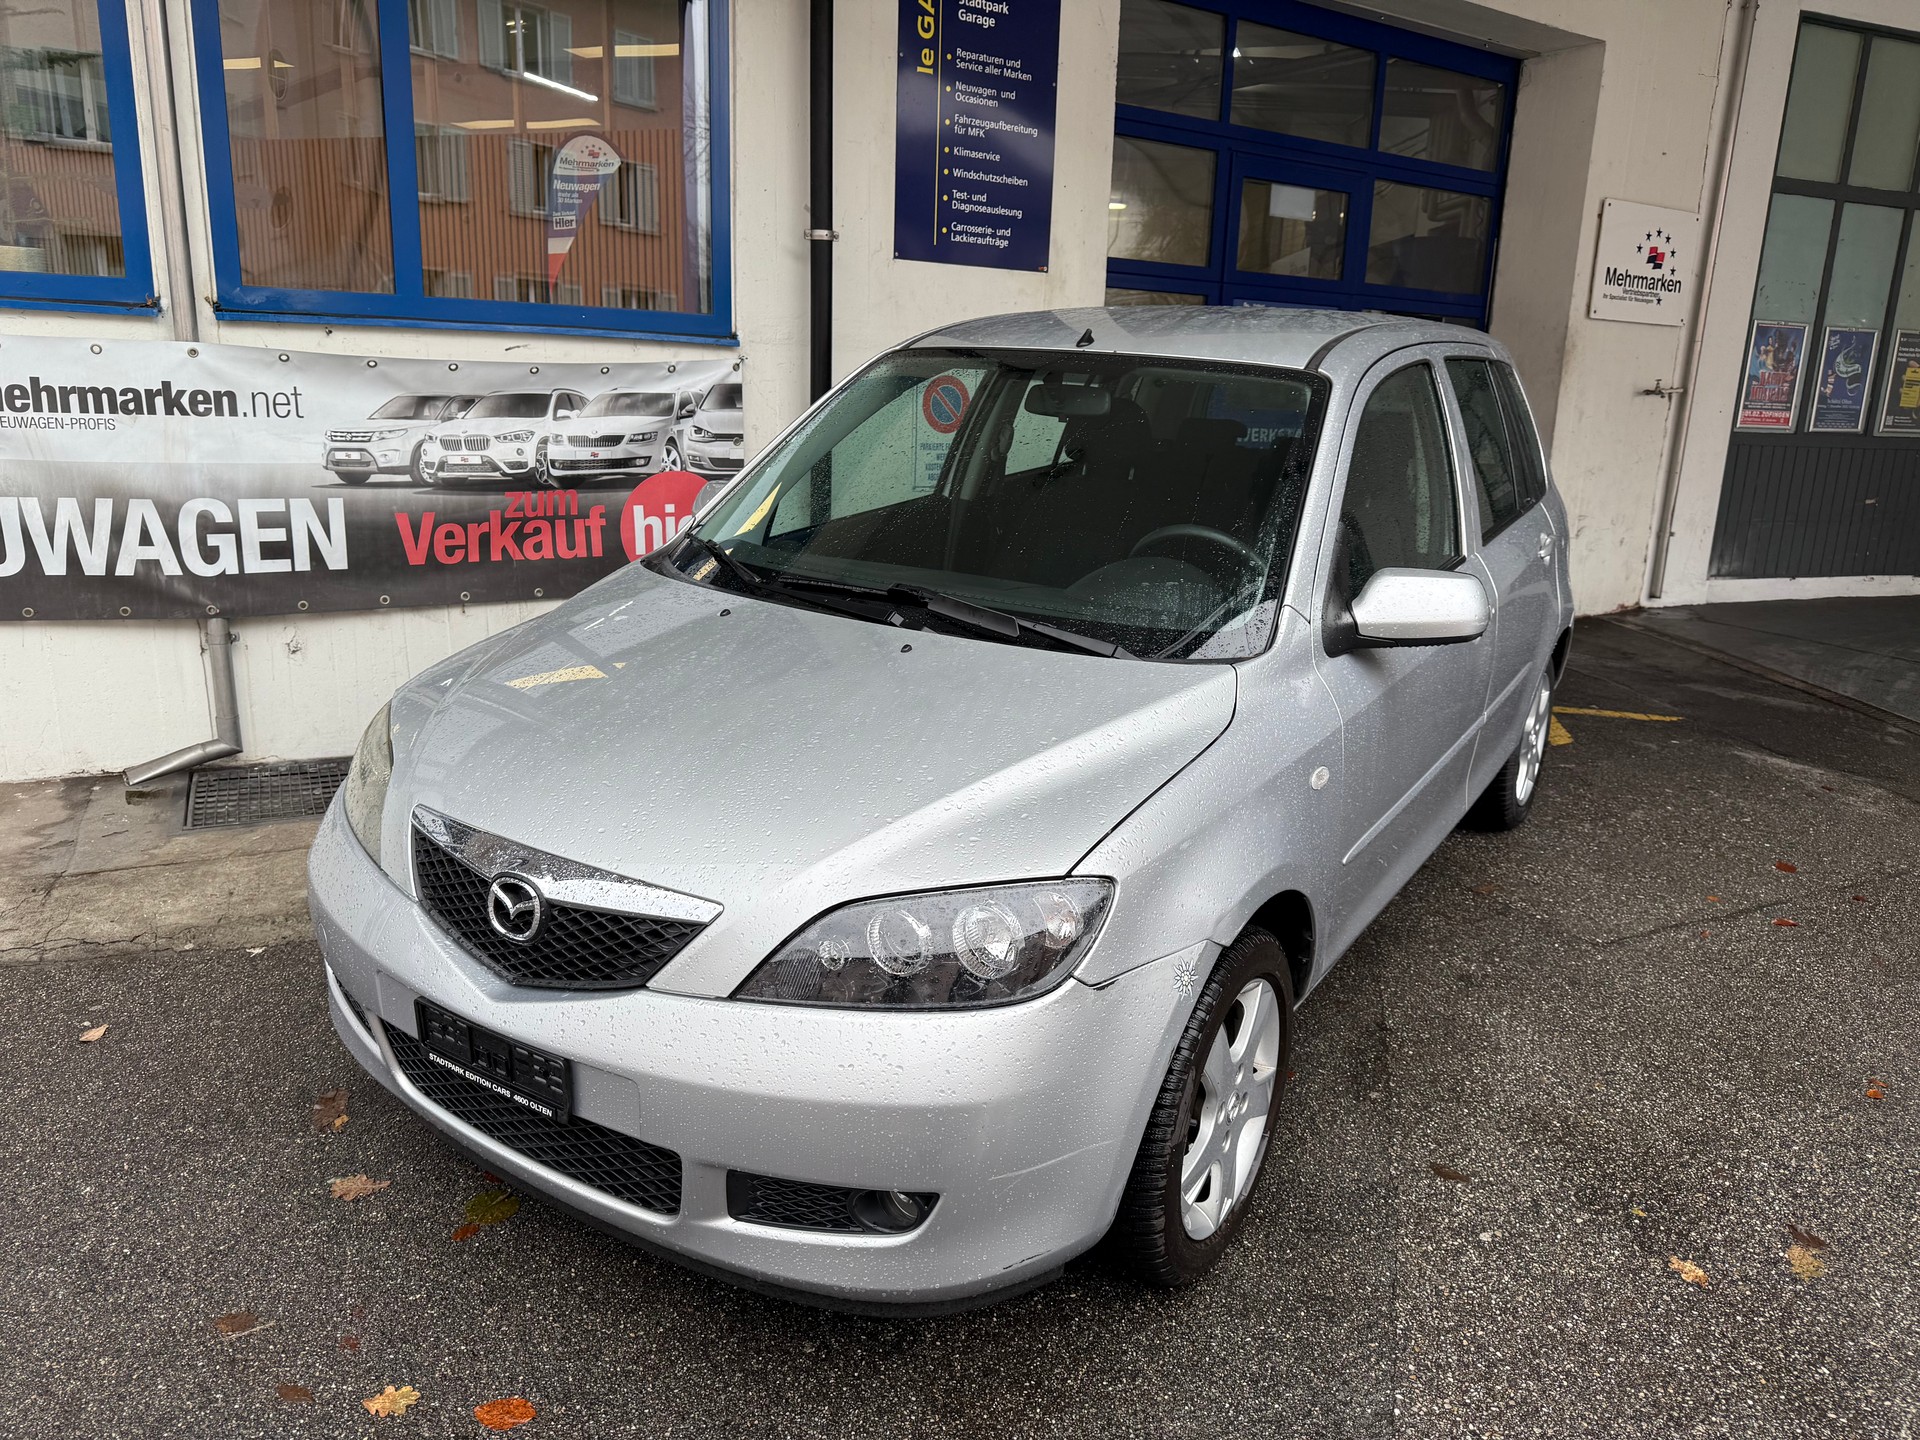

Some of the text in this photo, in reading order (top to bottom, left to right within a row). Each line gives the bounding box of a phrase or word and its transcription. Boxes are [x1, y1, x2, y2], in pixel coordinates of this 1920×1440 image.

[958, 9, 996, 29] Garage
[917, 48, 934, 75] le
[956, 48, 1021, 69] Reparaturen und
[956, 59, 1032, 82] Service aller Marken
[955, 81, 1016, 100] Neuwagen und
[955, 92, 999, 108] Occasionen
[954, 114, 1038, 138] Fahrzeugaufbereitung
[954, 124, 986, 138] für MFK
[559, 157, 615, 168] Mehrmarken
[953, 146, 1001, 162] Klimaservice
[553, 179, 601, 193] Neuwagen
[952, 168, 1029, 187] Windschutzscheiben
[952, 189, 987, 202] Test- und
[952, 201, 1023, 219] Diagnoseauslesung
[951, 221, 1012, 237] Carrosserie- und
[951, 233, 1009, 249] Lackieraufträge
[1604, 266, 1682, 294] Mehrmarken
[504, 488, 578, 518] zum
[395, 505, 607, 566] Verkauf
[429, 1053, 553, 1118] STADTPARK EDITION CARS 4600 OLTEN
